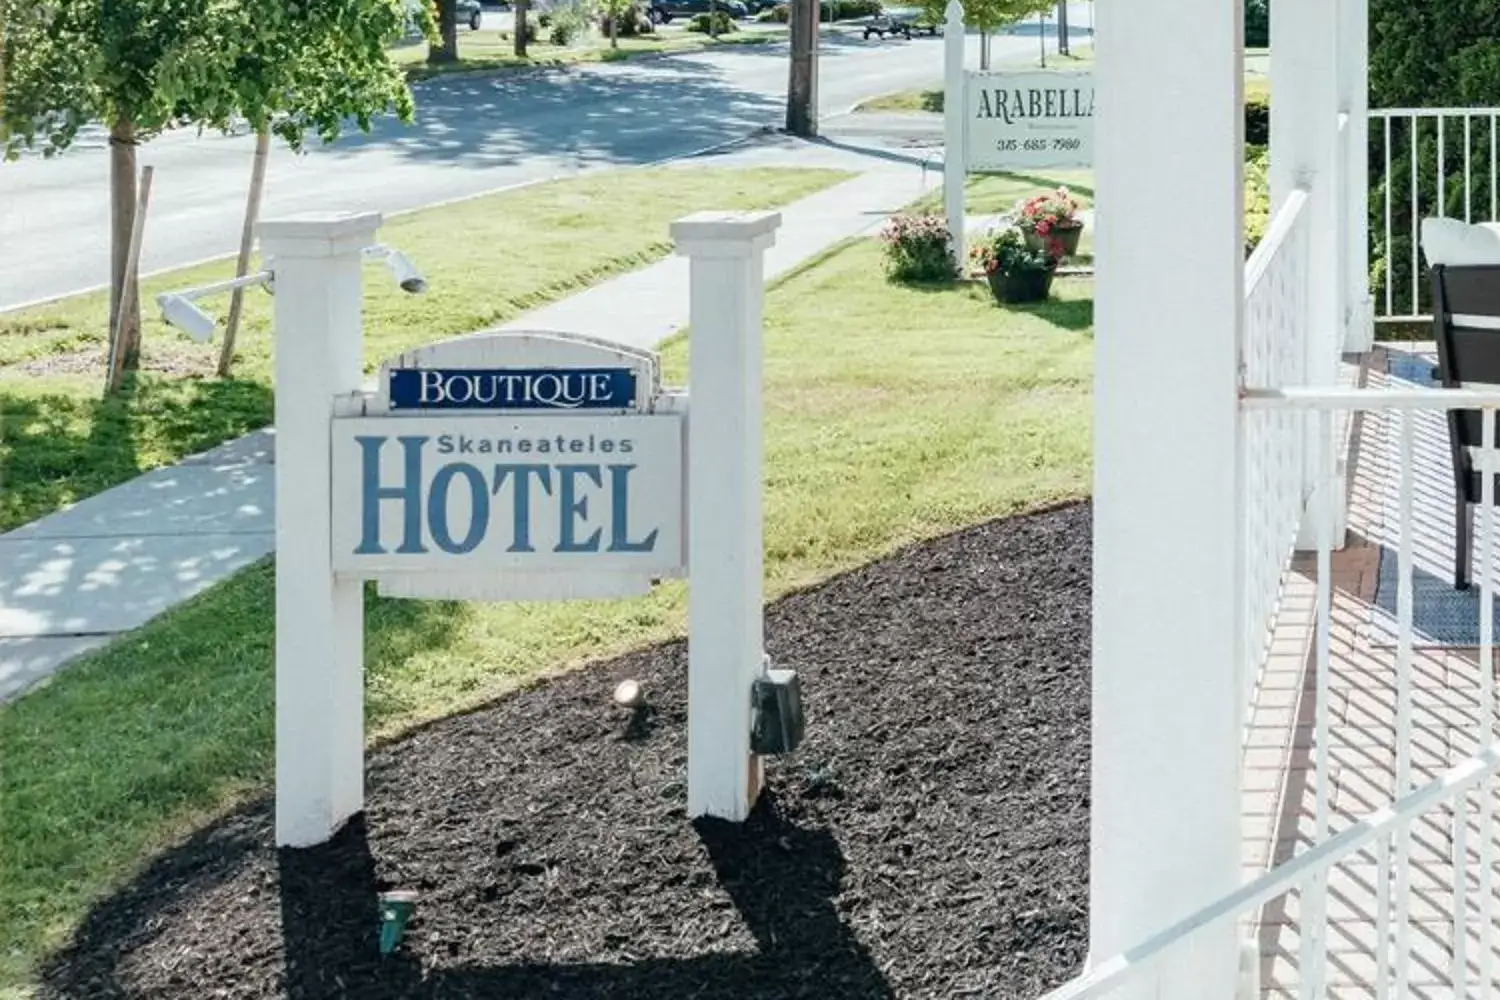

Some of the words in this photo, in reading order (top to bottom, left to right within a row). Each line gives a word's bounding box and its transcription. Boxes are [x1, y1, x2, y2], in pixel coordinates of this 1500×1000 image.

[419, 371, 613, 408] BOUTIQUE
[437, 434, 634, 454] Skaneateles
[353, 435, 659, 555] HOTEL
